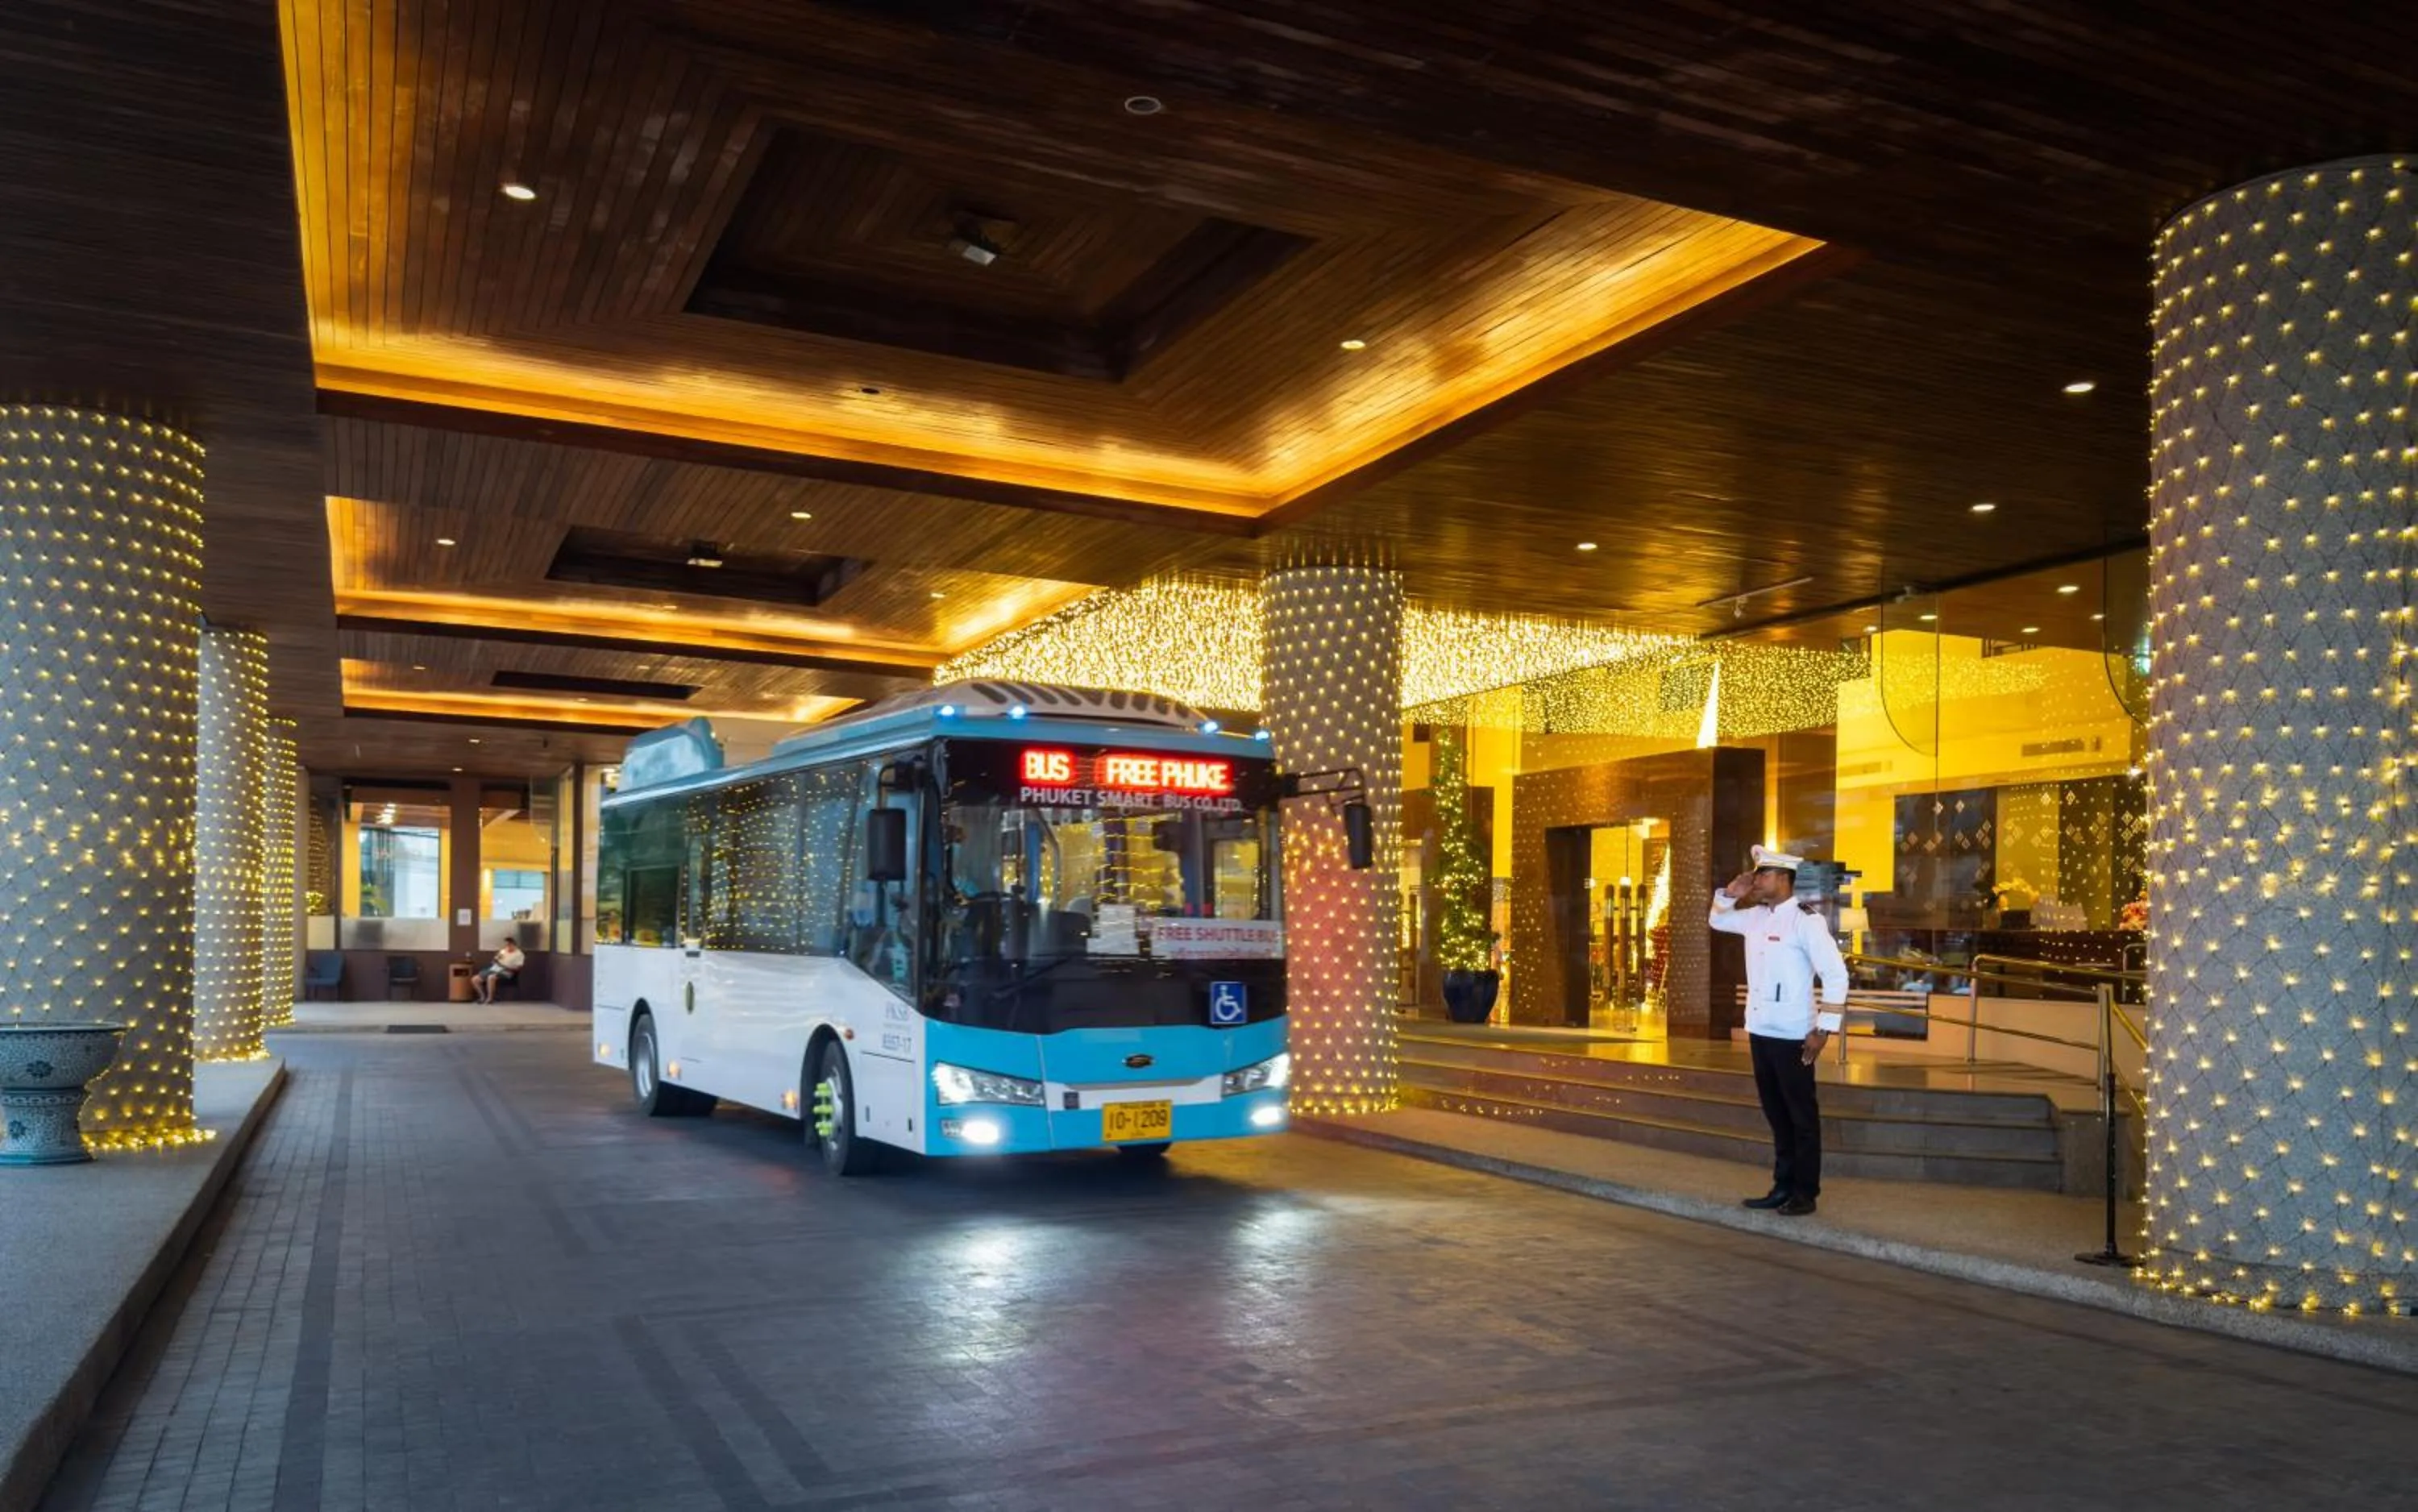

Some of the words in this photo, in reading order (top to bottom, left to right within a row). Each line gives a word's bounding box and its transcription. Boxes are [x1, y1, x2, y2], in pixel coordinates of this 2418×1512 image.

[1024, 750, 1071, 782] BUS
[1106, 758, 1160, 787] FREE
[1020, 786, 1092, 805] PHUKET
[1096, 790, 1155, 808] SMART
[1163, 793, 1192, 809] BUS
[1157, 926, 1193, 941] FREE
[1196, 927, 1255, 942] SHUTTLE
